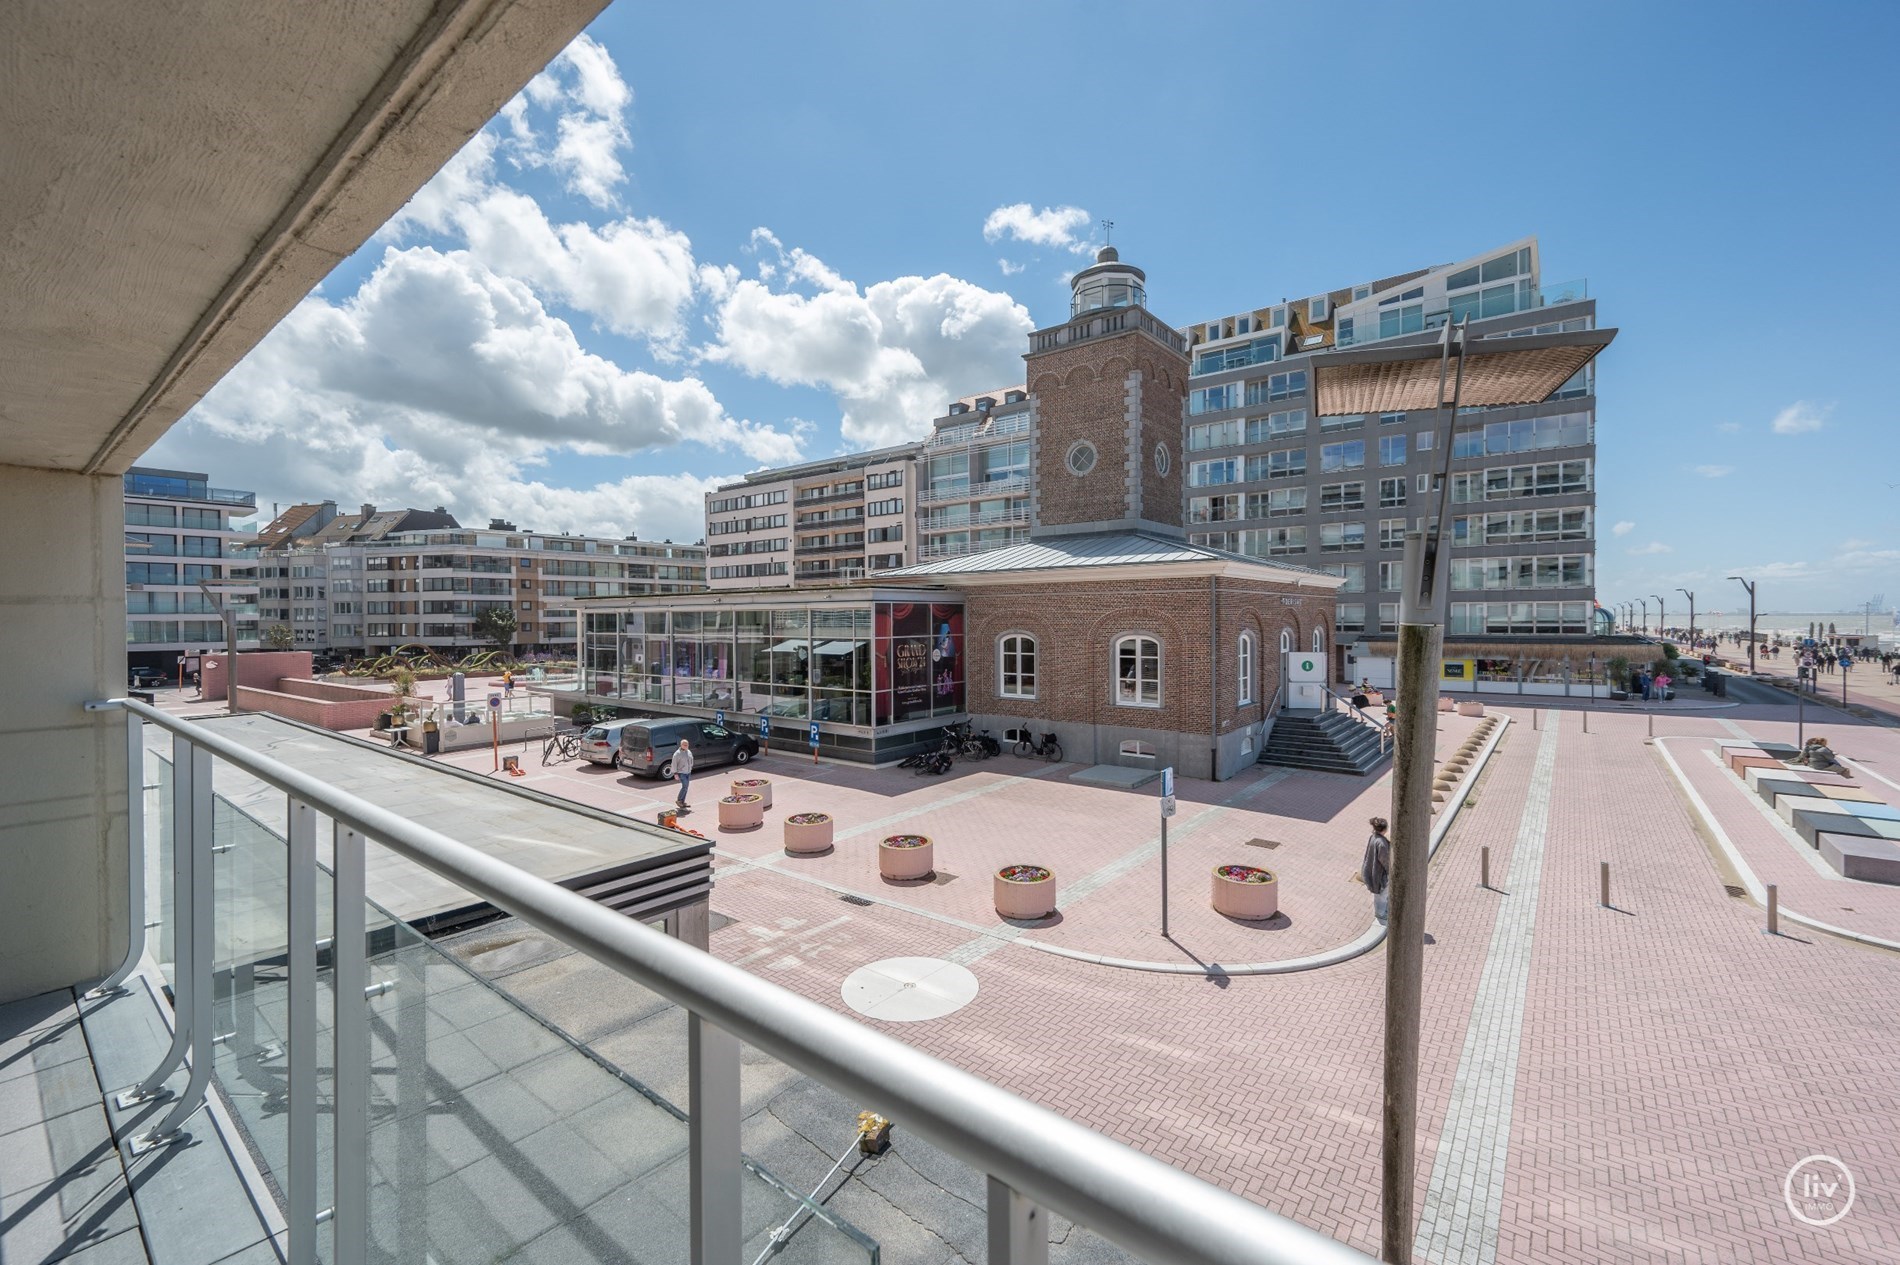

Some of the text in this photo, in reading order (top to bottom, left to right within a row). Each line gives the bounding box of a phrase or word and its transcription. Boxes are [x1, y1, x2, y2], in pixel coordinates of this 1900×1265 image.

[717, 713, 723, 724] P
[761, 719, 767, 731] P
[811, 726, 817, 738] P
